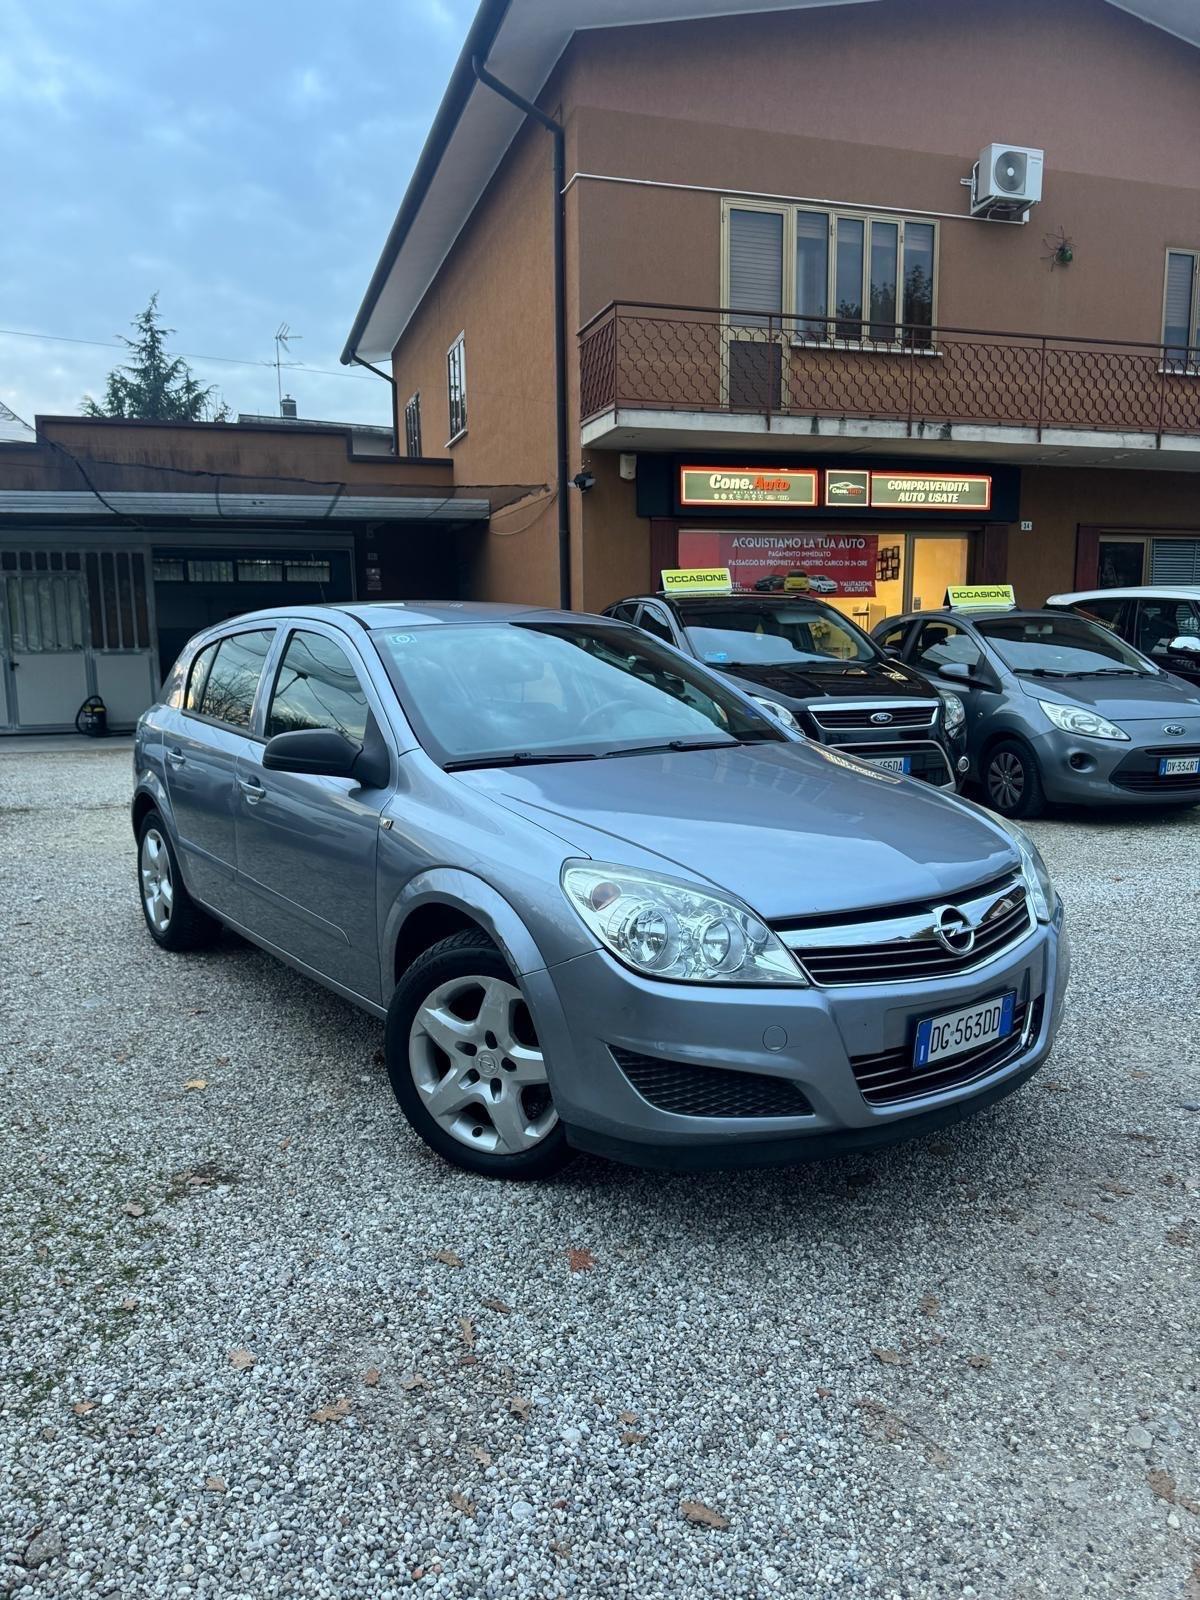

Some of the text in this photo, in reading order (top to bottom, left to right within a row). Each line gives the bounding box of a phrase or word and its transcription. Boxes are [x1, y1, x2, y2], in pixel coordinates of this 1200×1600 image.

[709, 474, 790, 491] Cone.Auto
[887, 480, 970, 492] COMPRAVENDITA
[897, 493, 959, 503] AUTO USATE
[732, 537, 866, 549] ACQUISTIAMO LA TUA AUTO
[666, 574, 728, 583] OCCASIONE
[952, 590, 1011, 598] OCCASIONE
[930, 1022, 950, 1054] DG
[954, 1006, 1001, 1046] 563DD
